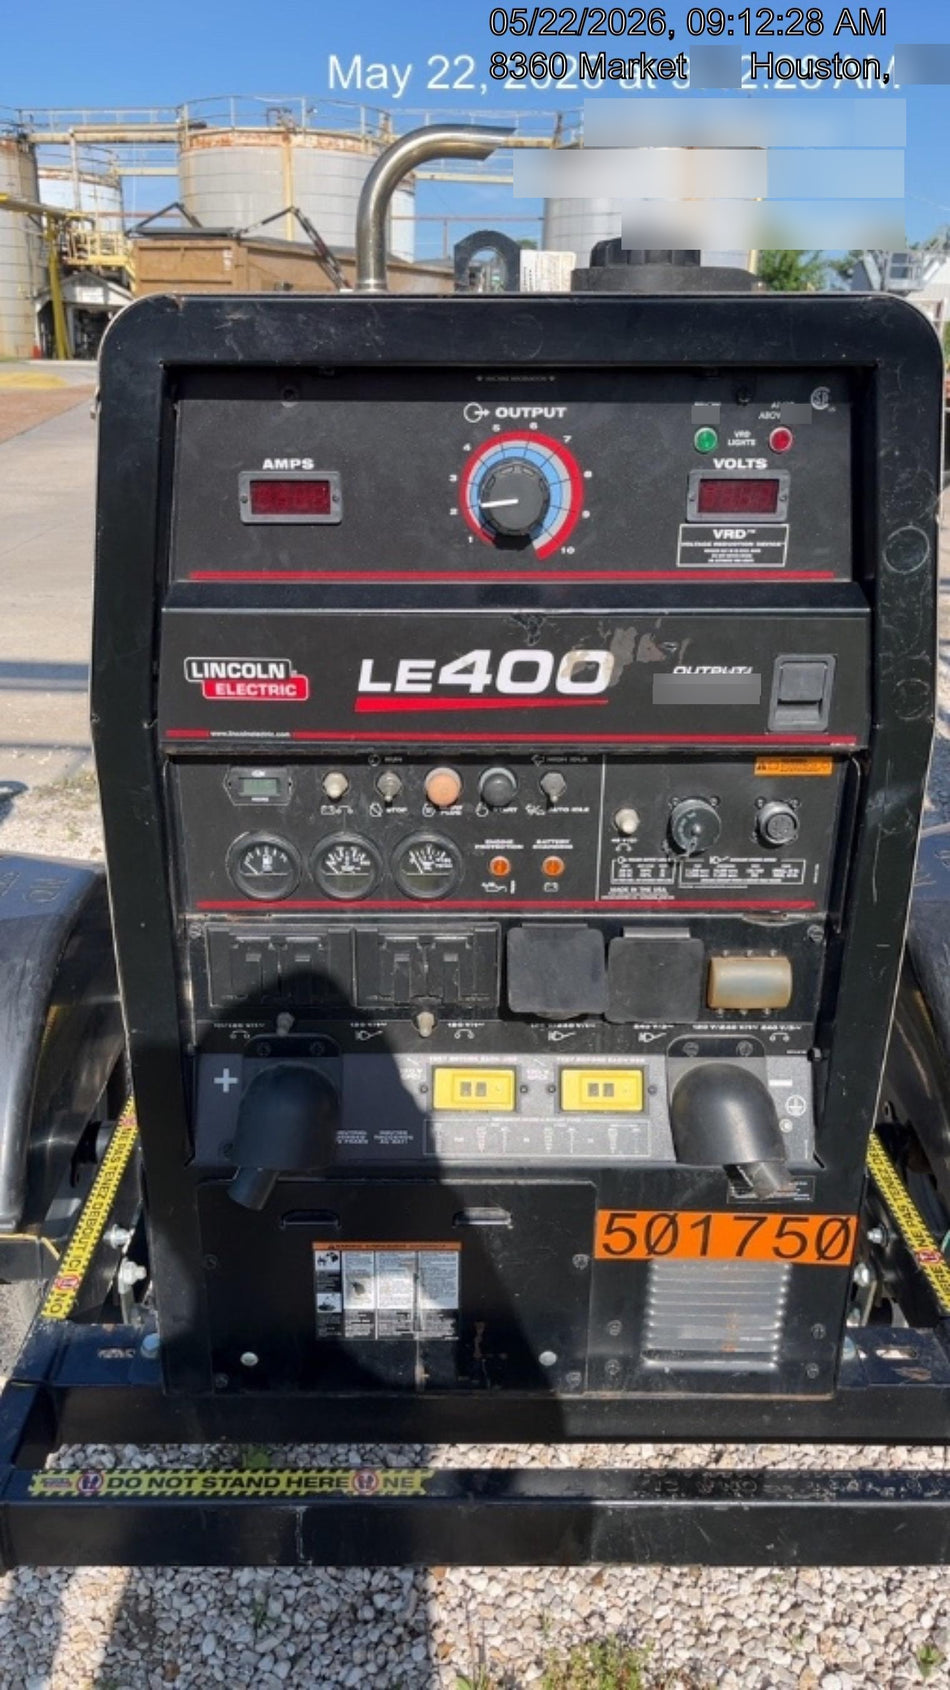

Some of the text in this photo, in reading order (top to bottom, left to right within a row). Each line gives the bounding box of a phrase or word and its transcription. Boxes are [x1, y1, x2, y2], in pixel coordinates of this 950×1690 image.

[495, 406, 567, 418] OUTPUT
[563, 435, 572, 443] 7
[262, 458, 315, 470] AMPS
[713, 458, 768, 470] VOLTS
[191, 661, 286, 679] LINCOLN
[215, 683, 297, 696] ELECTRIC
[75, 1201, 104, 1253] DEBOUT
[106, 1476, 414, 1489] DO NOT STAND HERE NE
